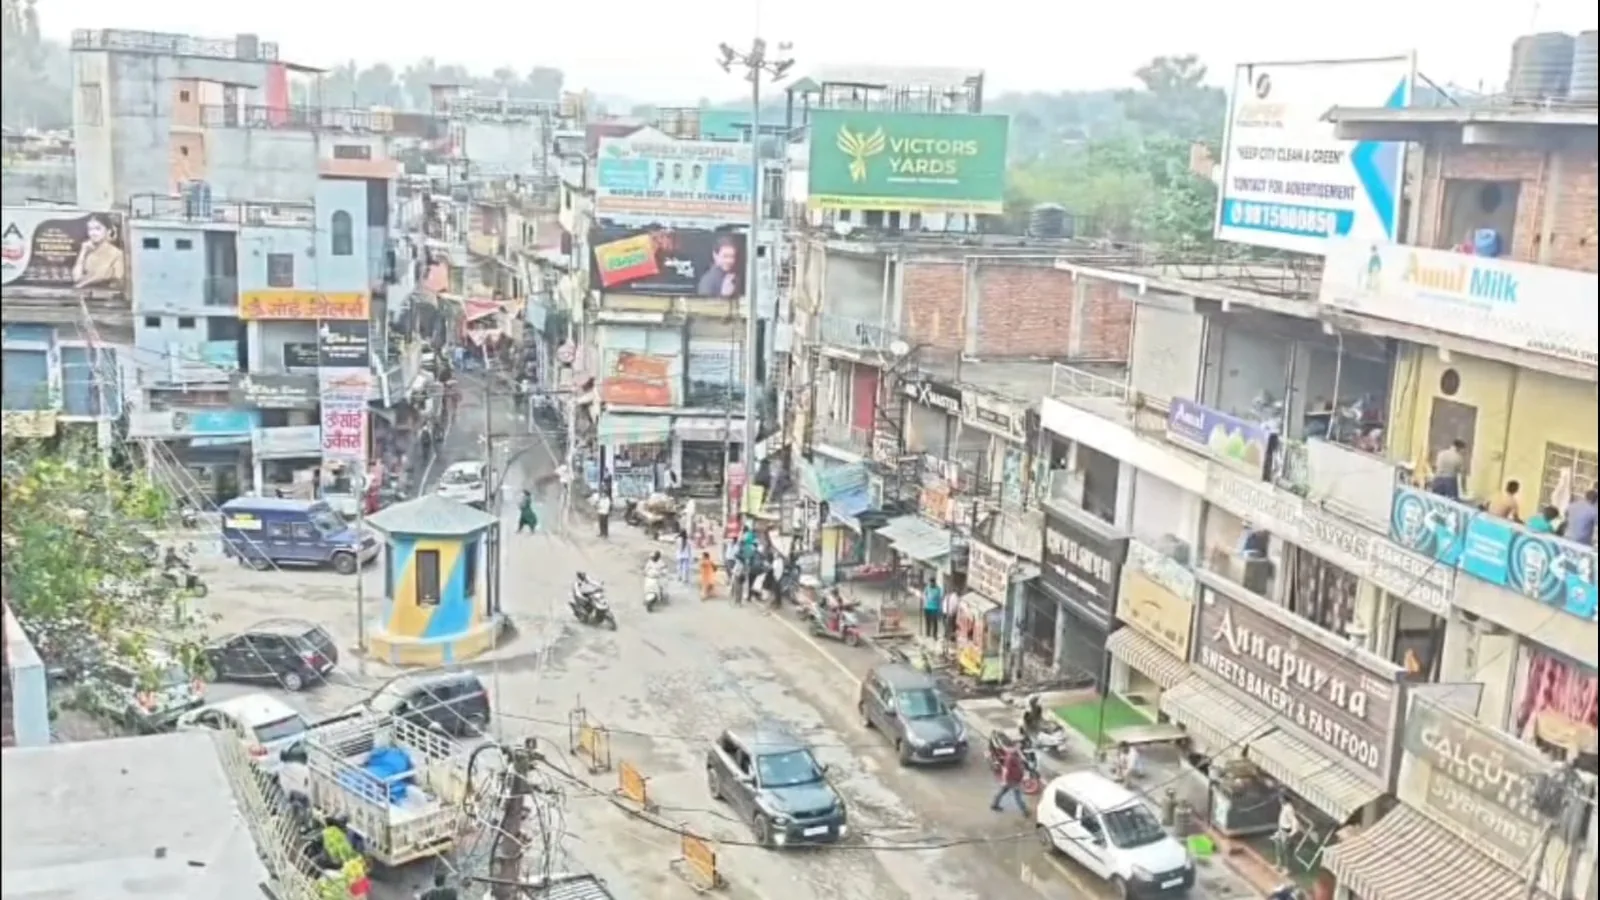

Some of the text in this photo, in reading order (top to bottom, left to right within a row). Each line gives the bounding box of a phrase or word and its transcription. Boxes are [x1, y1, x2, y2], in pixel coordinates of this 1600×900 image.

[888, 156, 957, 175] YARDS
[889, 137, 978, 156] VICTORS
[1403, 252, 1467, 292] Amul
[1470, 266, 1519, 302] Milk
[1173, 403, 1204, 430] Amul
[1214, 606, 1368, 719] Annapurna
[1201, 645, 1245, 687] SWEETS
[1246, 668, 1294, 718] BAKERY
[1296, 702, 1306, 725] &
